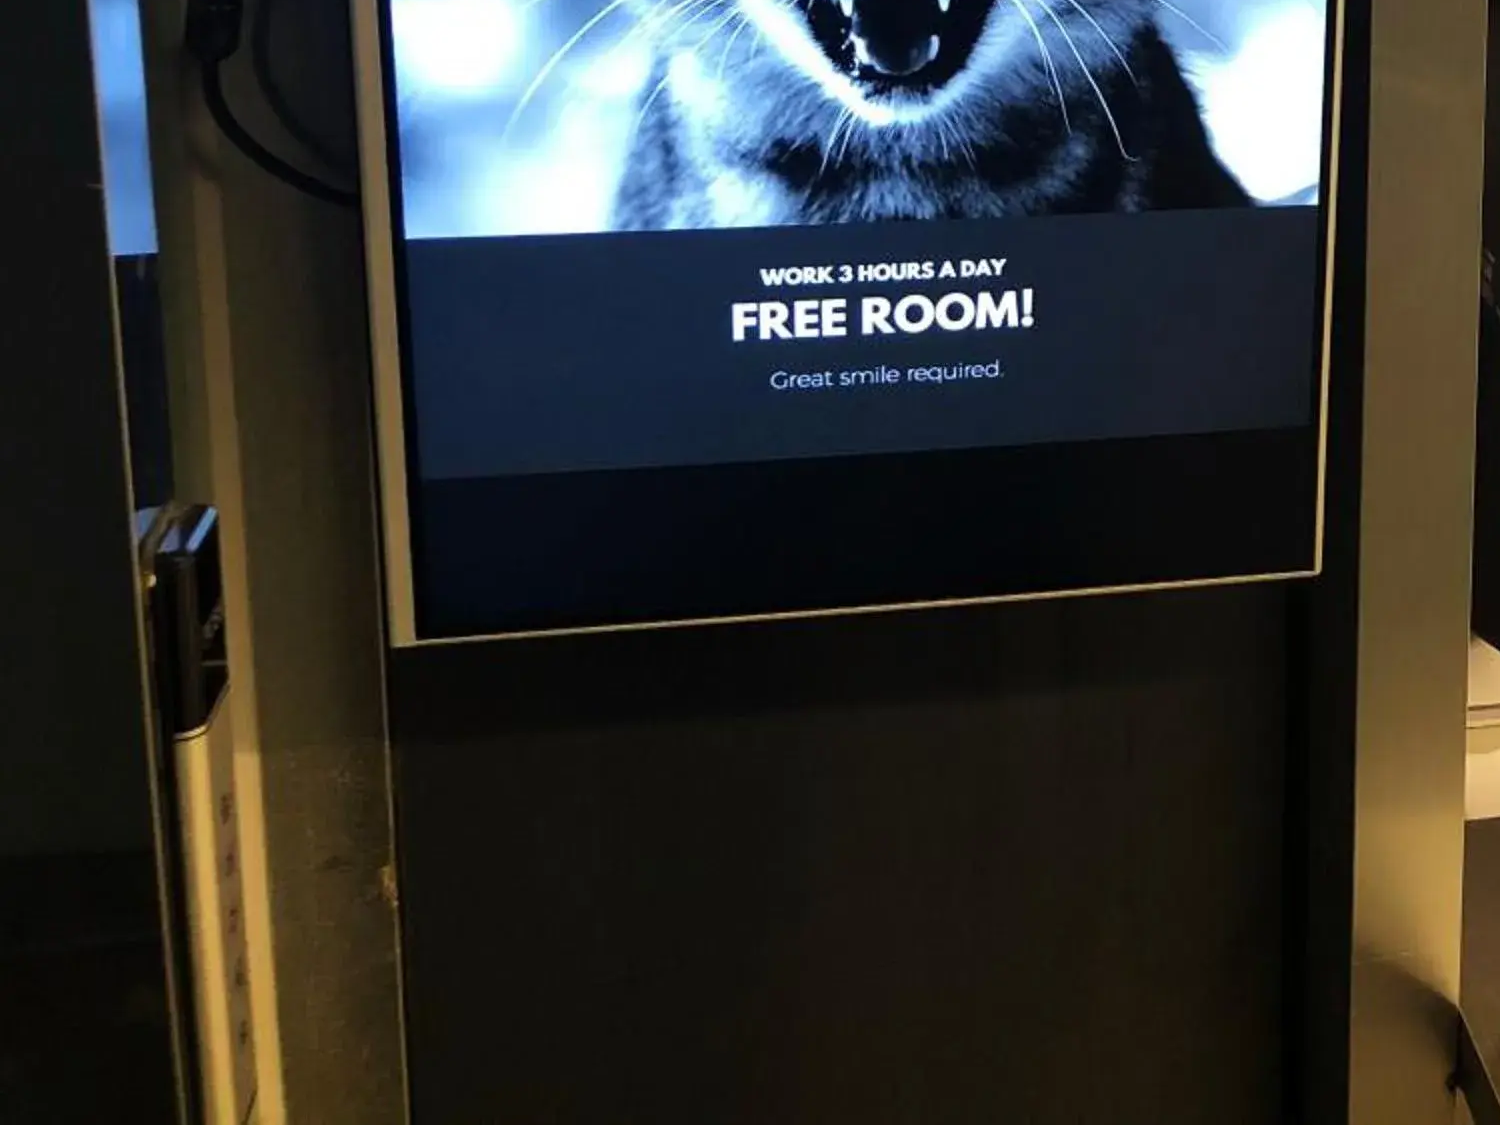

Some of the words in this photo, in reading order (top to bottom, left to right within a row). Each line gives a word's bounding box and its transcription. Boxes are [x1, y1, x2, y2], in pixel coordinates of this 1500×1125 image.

[759, 265, 834, 287] WORK
[838, 264, 854, 284] 3
[857, 260, 935, 283] HOURS
[938, 260, 957, 279] A
[960, 257, 1008, 278] DAY
[730, 298, 848, 342] FREE
[860, 287, 1035, 335] ROOM!
[769, 369, 835, 391] Great
[839, 364, 901, 386] smile
[906, 358, 1004, 385] required.
